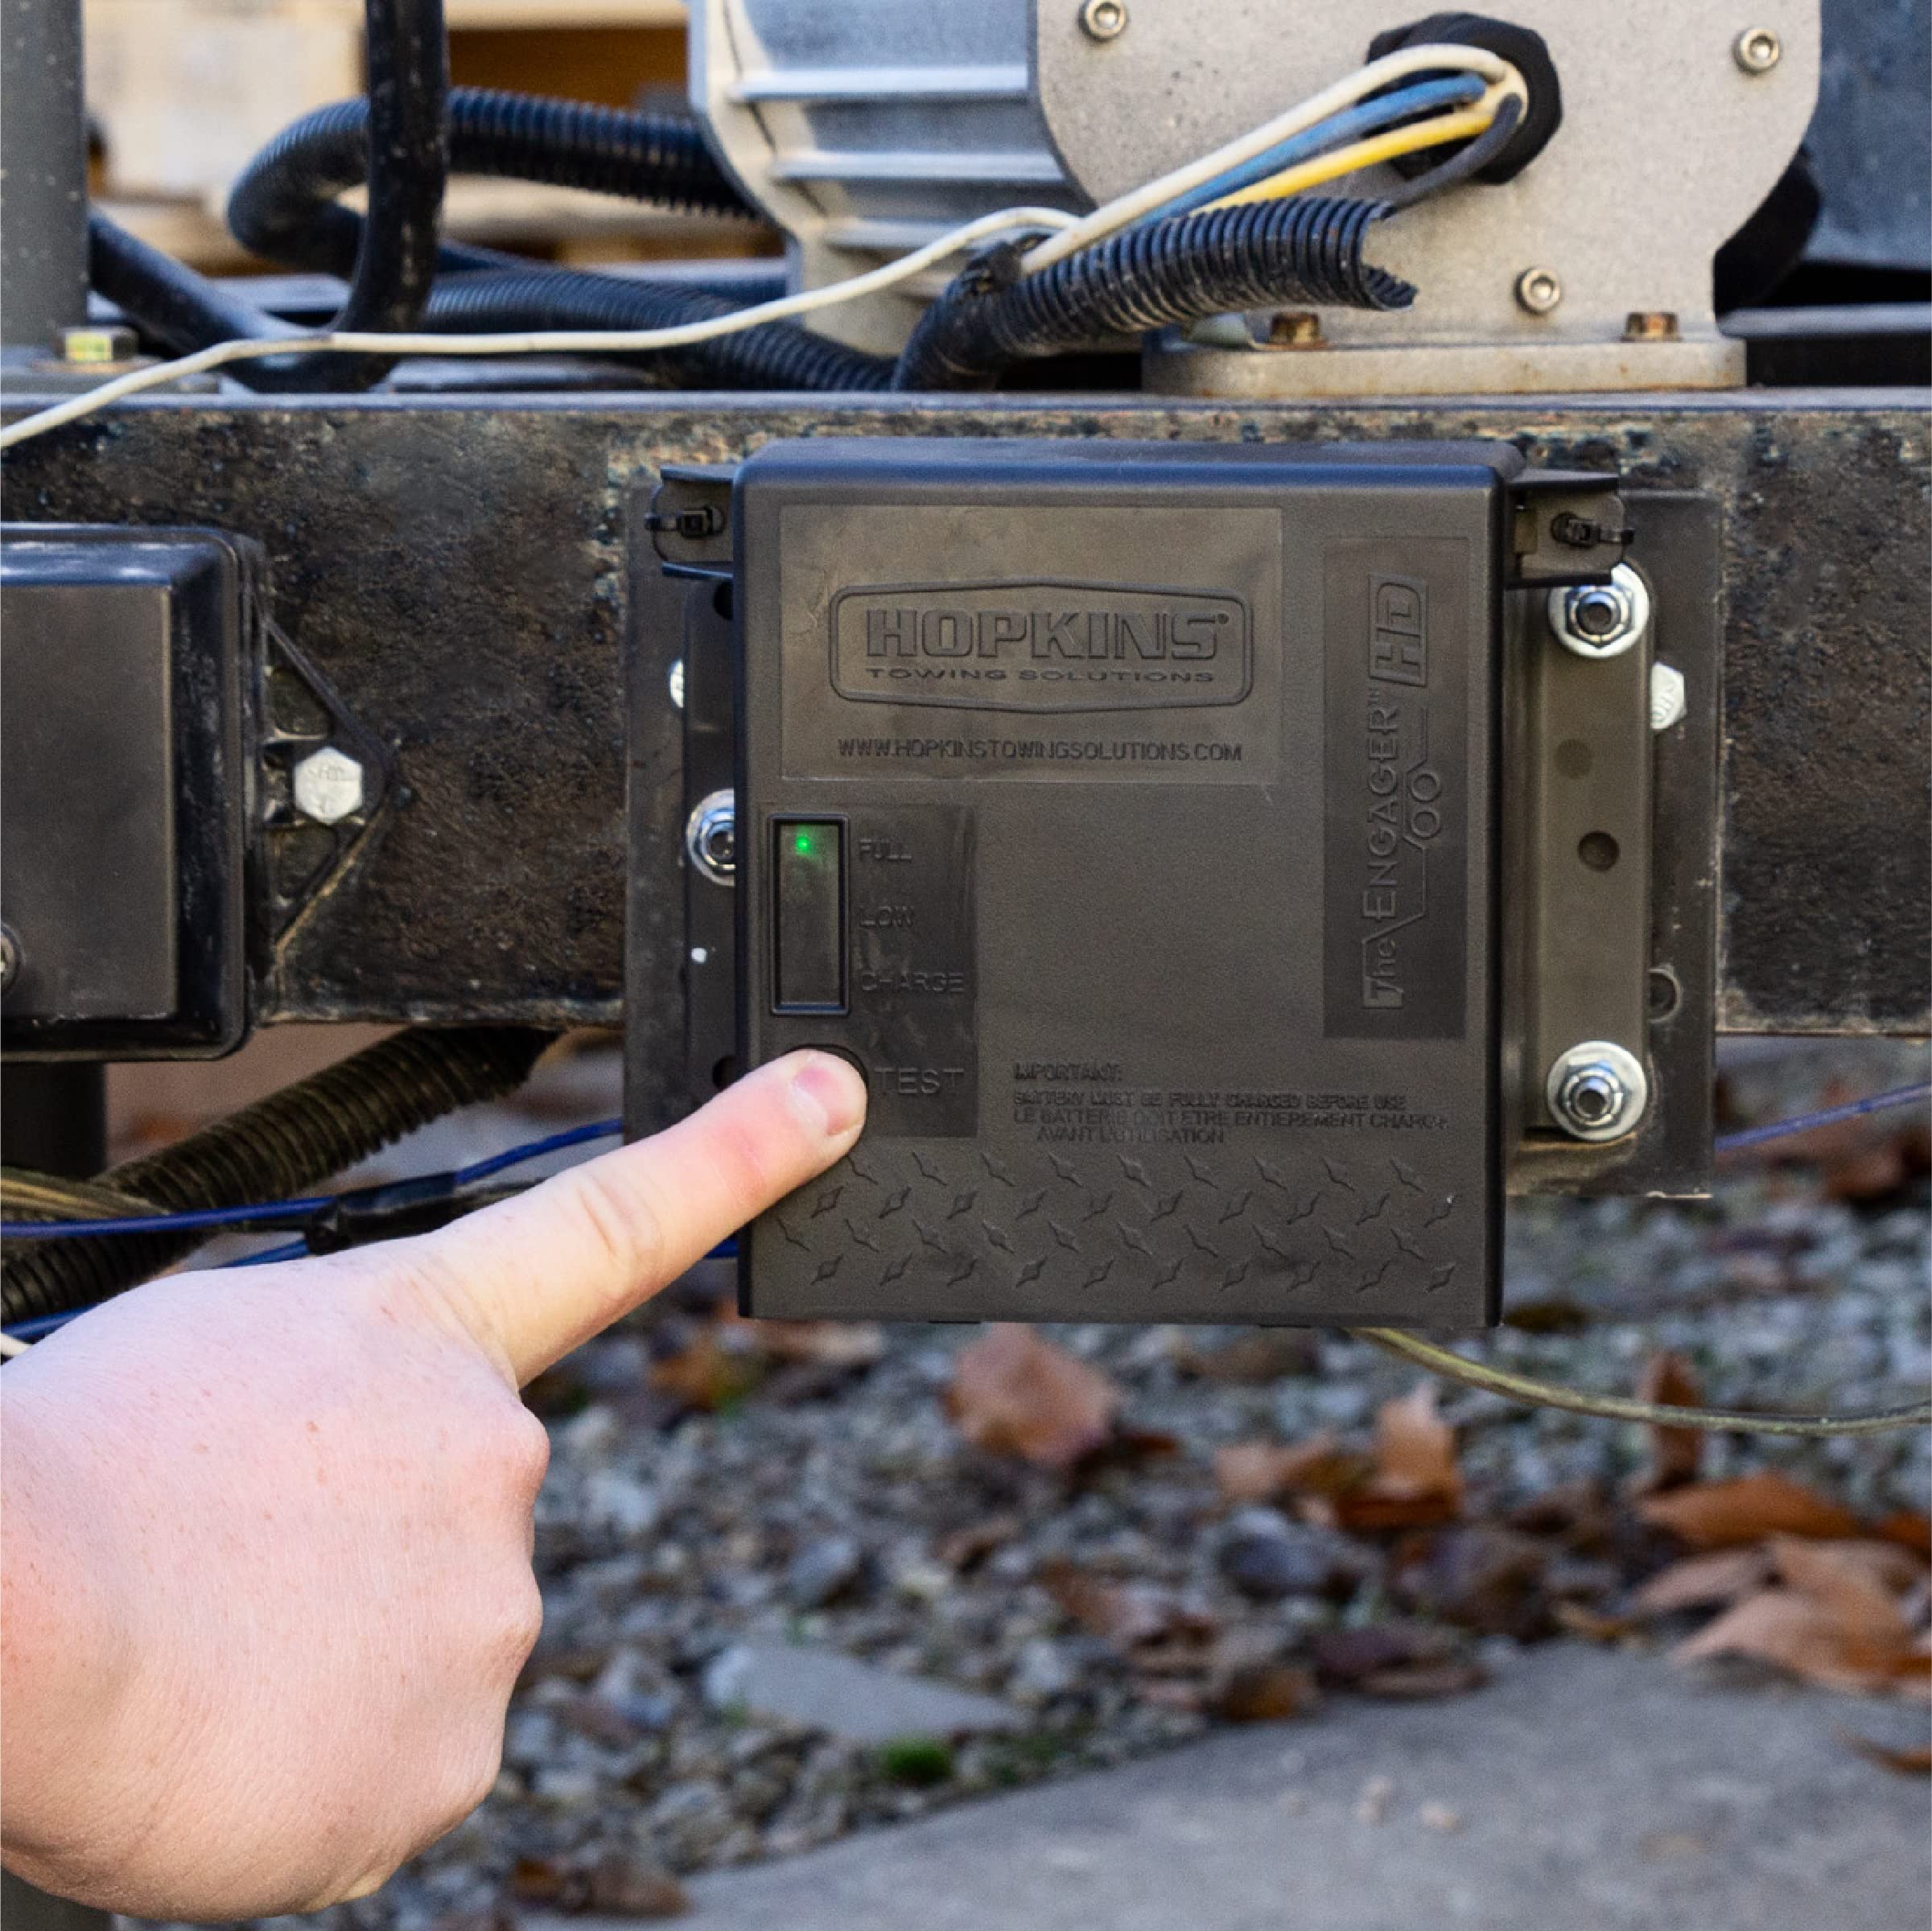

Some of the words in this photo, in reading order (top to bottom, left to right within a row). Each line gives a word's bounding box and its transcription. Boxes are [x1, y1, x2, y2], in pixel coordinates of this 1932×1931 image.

[1374, 579, 1423, 677] HD
[866, 668, 1006, 681] TOWING
[1018, 669, 1215, 683] SOLUTIONS
[838, 738, 1242, 762] WWW.HOPKINSTOWINGSOLUTIONS.COM
[859, 838, 912, 862] FULL
[859, 905, 913, 928] LOW
[861, 971, 965, 994] CHARGE
[1363, 938, 1403, 1009] The
[874, 1067, 965, 1095] TEST
[1013, 1107, 1036, 1124] LE
[1036, 1126, 1094, 1143] AVANT
